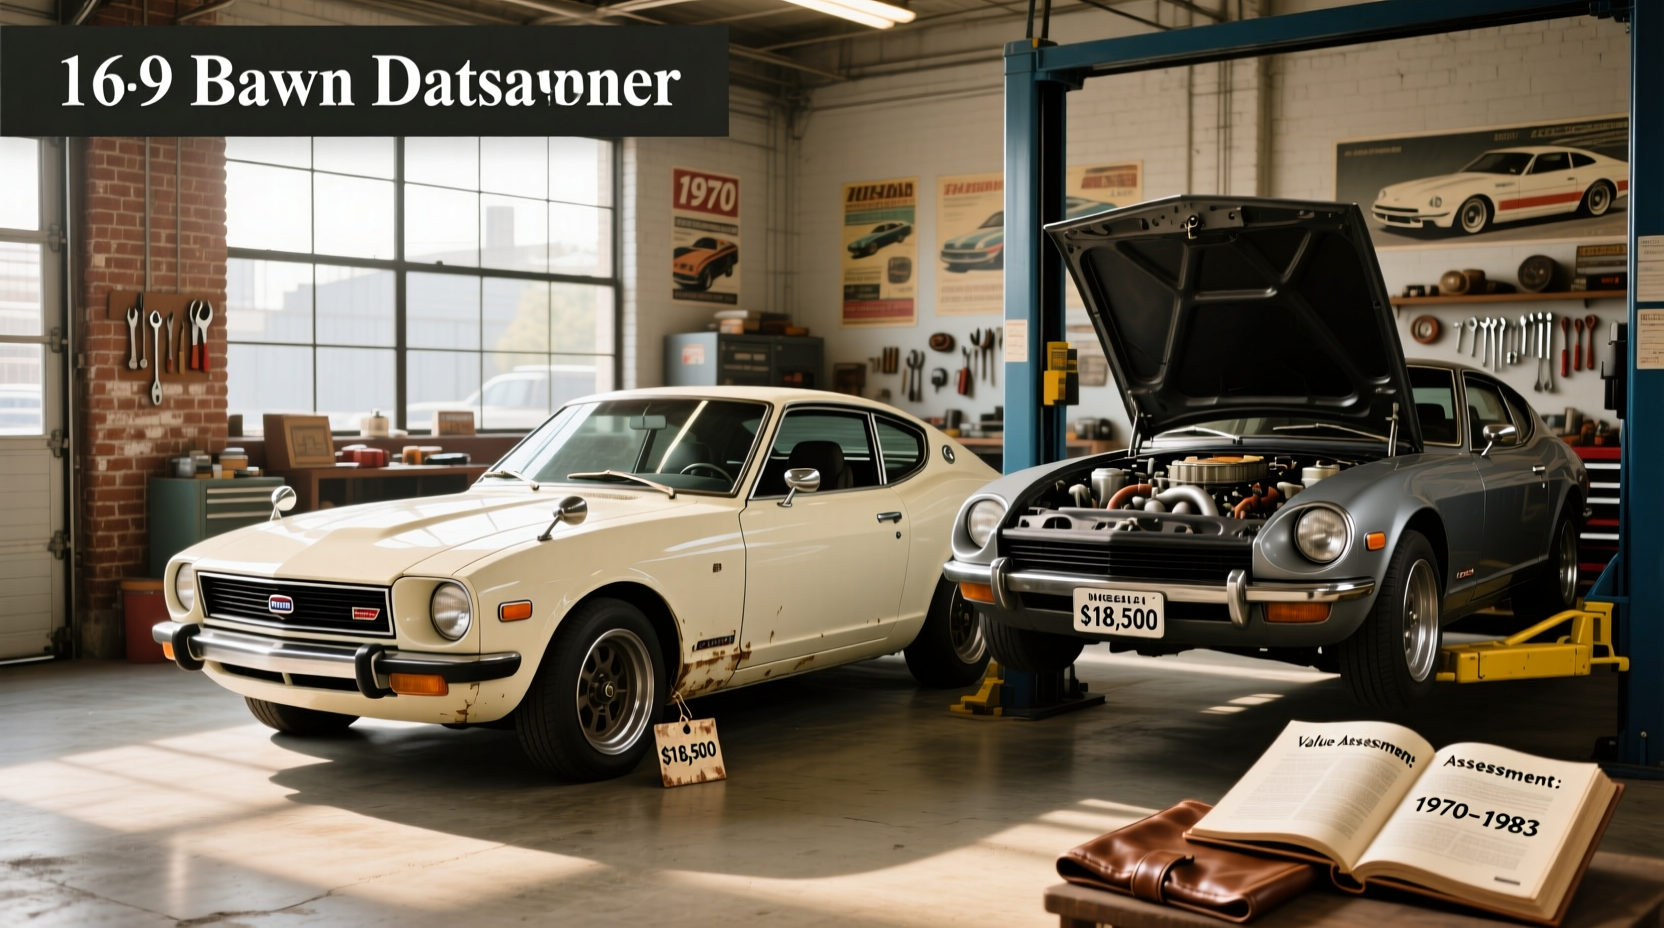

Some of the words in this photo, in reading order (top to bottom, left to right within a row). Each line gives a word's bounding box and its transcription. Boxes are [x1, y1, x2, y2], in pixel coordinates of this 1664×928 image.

[679, 175, 736, 212] 1970
[1081, 604, 1158, 631] $18,500
[661, 741, 716, 766] $18,500
[1299, 735, 1335, 747] Value
[1443, 755, 1562, 789] Assessment:
